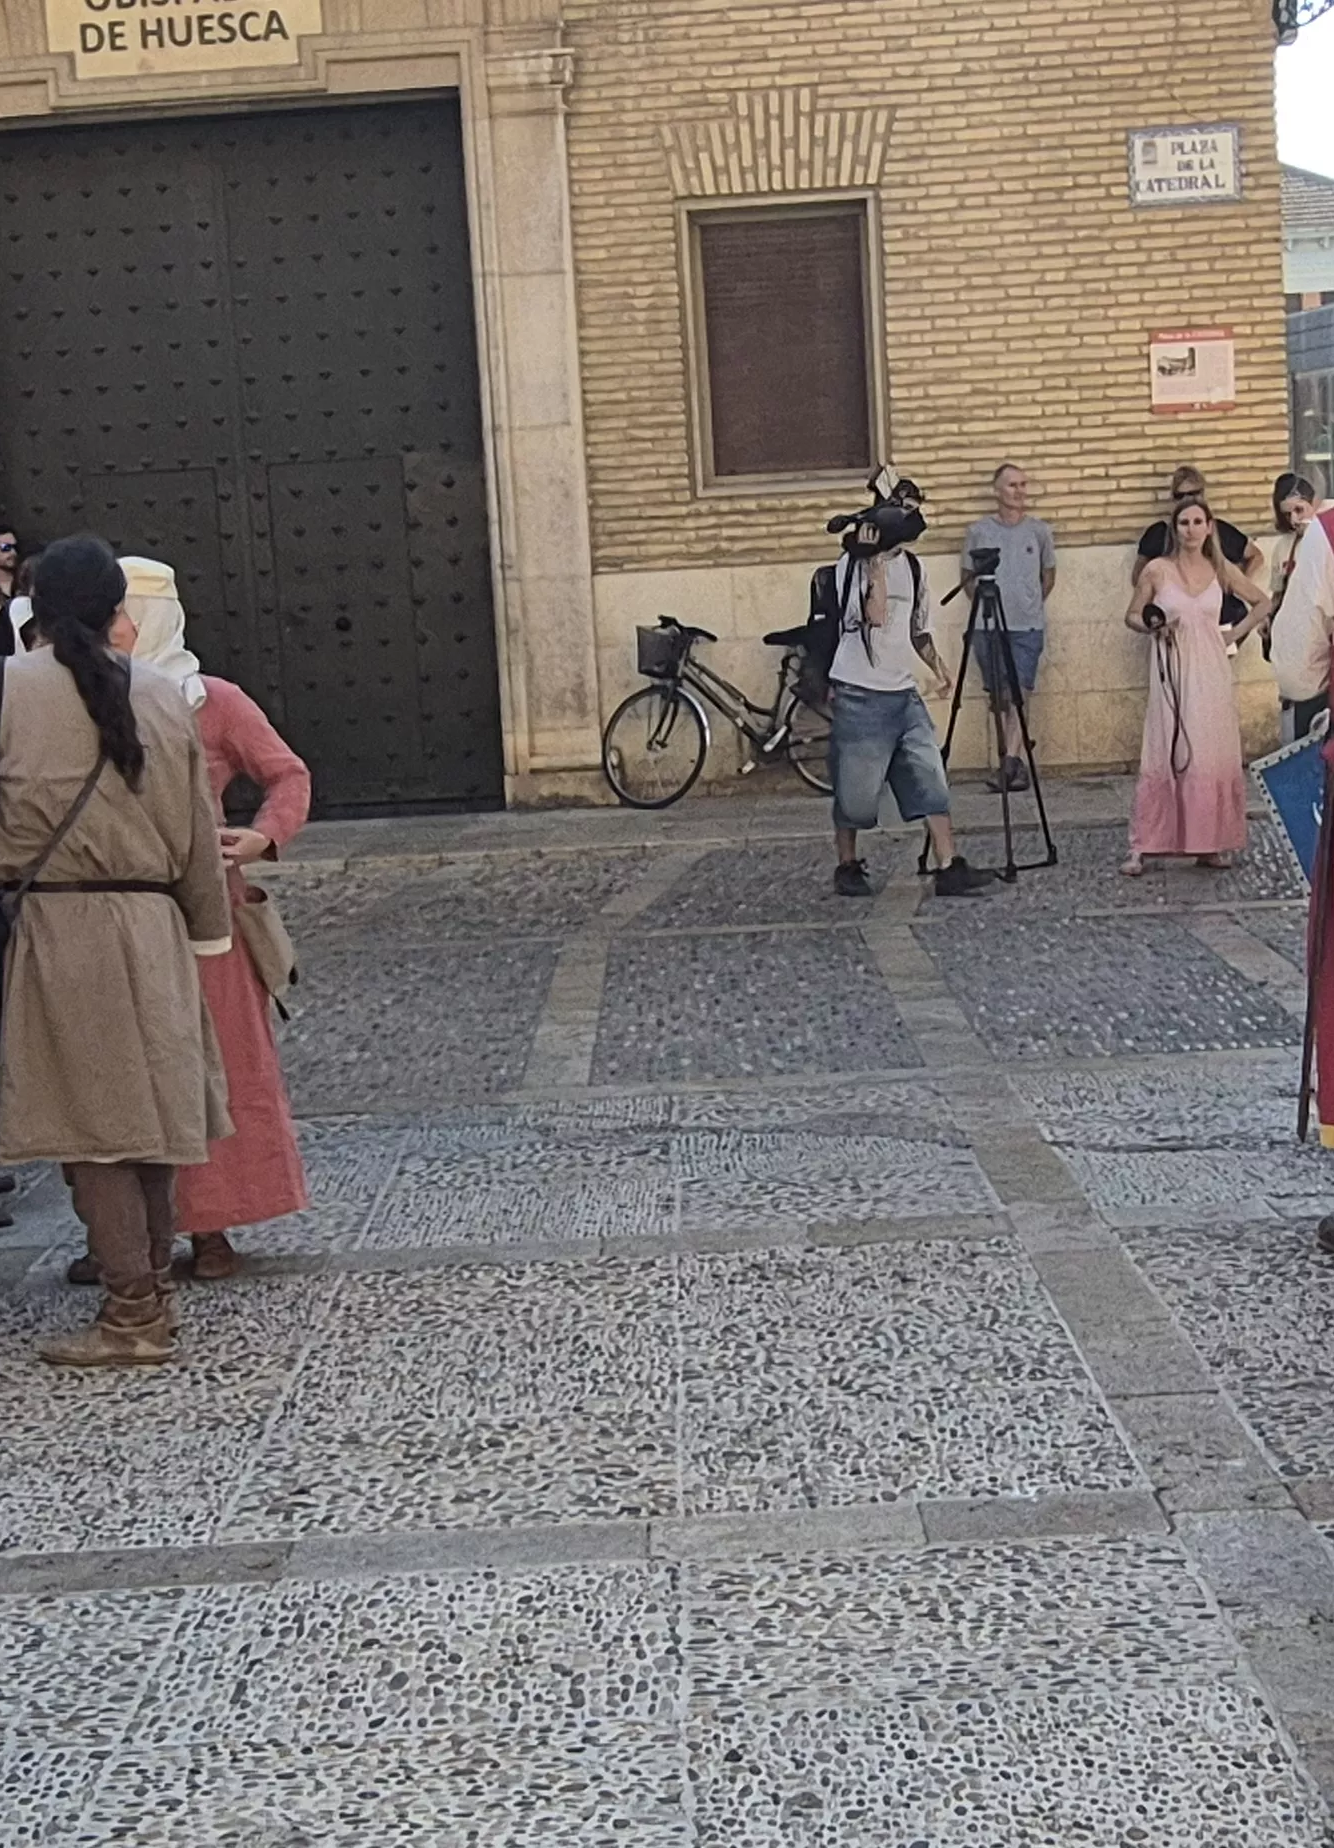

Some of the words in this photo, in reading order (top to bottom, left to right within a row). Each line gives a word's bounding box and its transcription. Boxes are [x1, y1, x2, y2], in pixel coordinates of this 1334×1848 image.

[79, 20, 128, 54] DE
[140, 10, 289, 49] HUESCA
[1170, 139, 1218, 155] PLAZA
[1177, 159, 1194, 172] DE
[1199, 158, 1215, 171] LA
[1135, 174, 1226, 193] CATEDRAL
